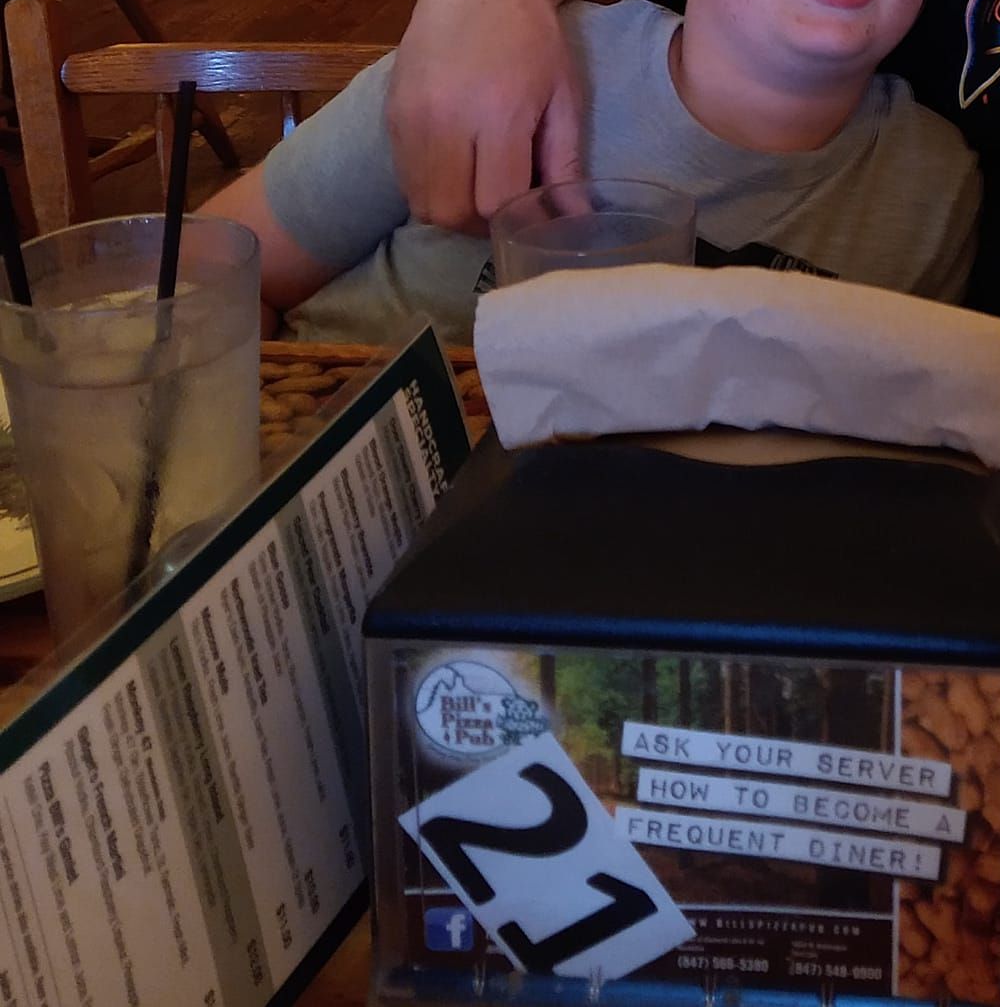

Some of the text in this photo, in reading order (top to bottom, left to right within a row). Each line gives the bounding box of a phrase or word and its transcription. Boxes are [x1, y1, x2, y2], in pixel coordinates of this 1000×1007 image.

[441, 695, 492, 713] Bill's
[442, 712, 494, 729] Pizza
[455, 729, 496, 745] Pub
[633, 732, 937, 787] ASK YOUR SERVER
[650, 778, 951, 833] HOW TO BECOME A
[418, 762, 659, 974] 21
[627, 817, 923, 872] FREQUENT DINER!
